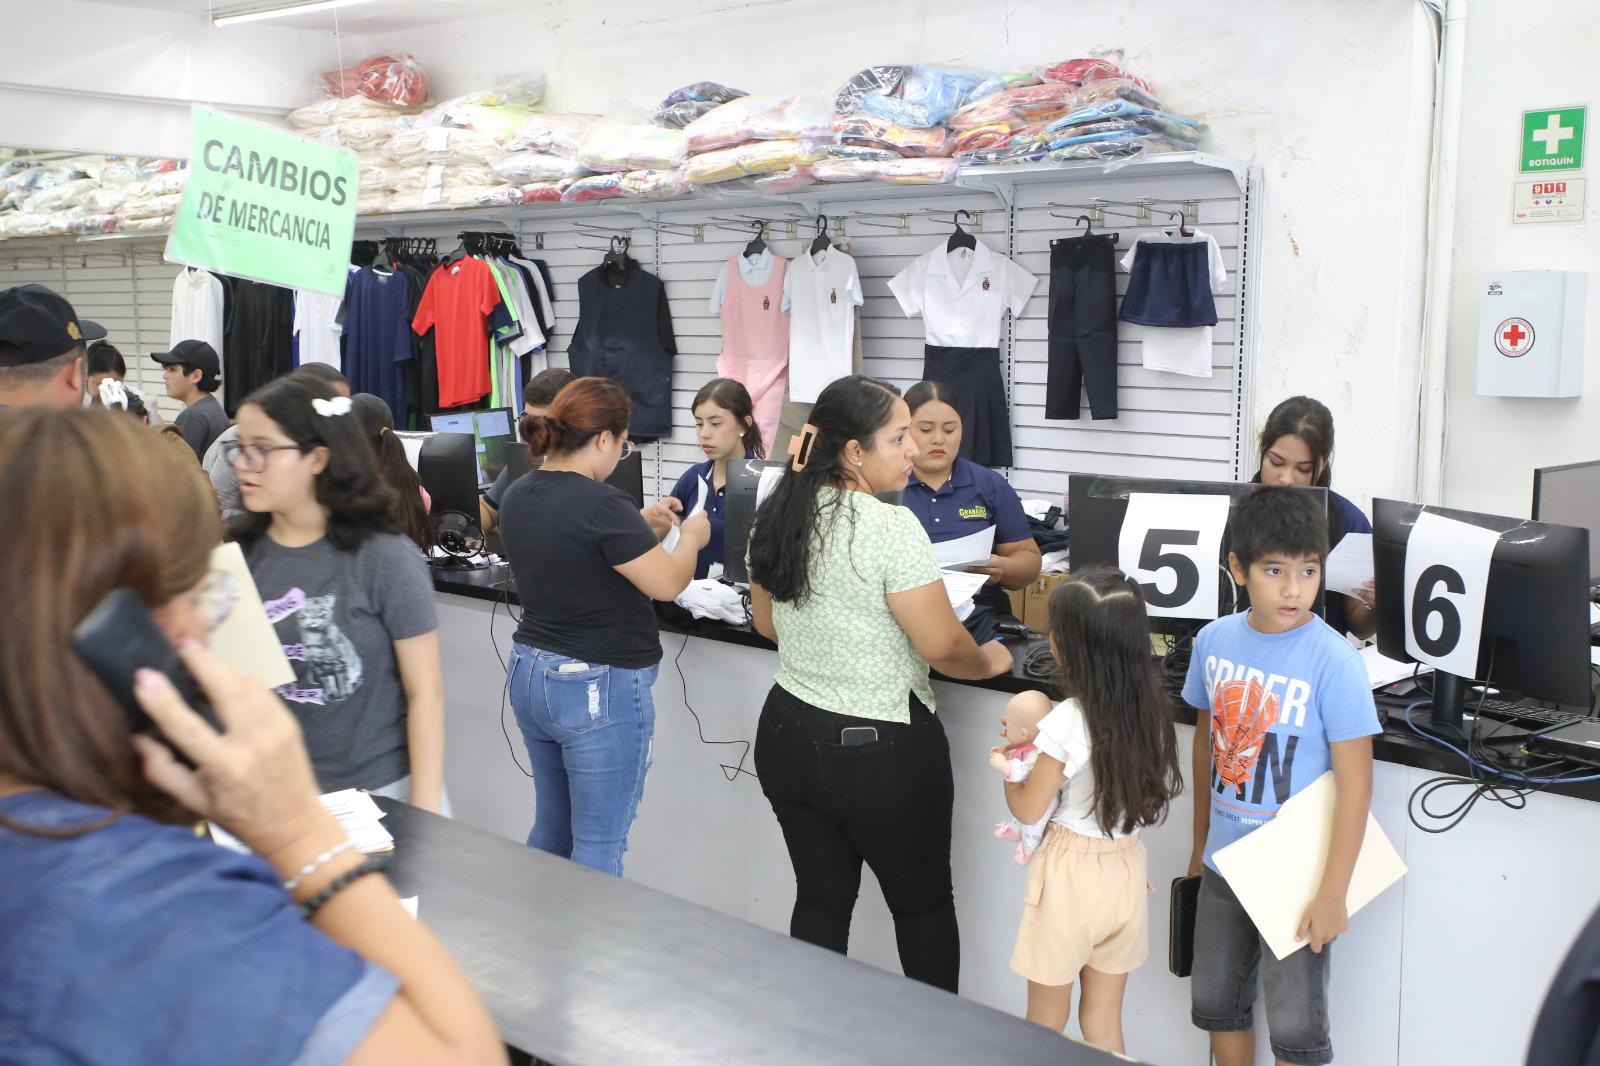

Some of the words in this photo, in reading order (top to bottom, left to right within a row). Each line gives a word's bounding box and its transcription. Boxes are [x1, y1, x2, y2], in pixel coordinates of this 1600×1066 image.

[203, 139, 347, 206] CAMBIOS
[1528, 155, 1574, 167] BOTIQUÍN
[1532, 183, 1566, 194] 911
[197, 191, 225, 224] DE
[228, 198, 331, 250] MERCANCIA
[1138, 528, 1200, 608] 5
[1412, 564, 1466, 657] 6
